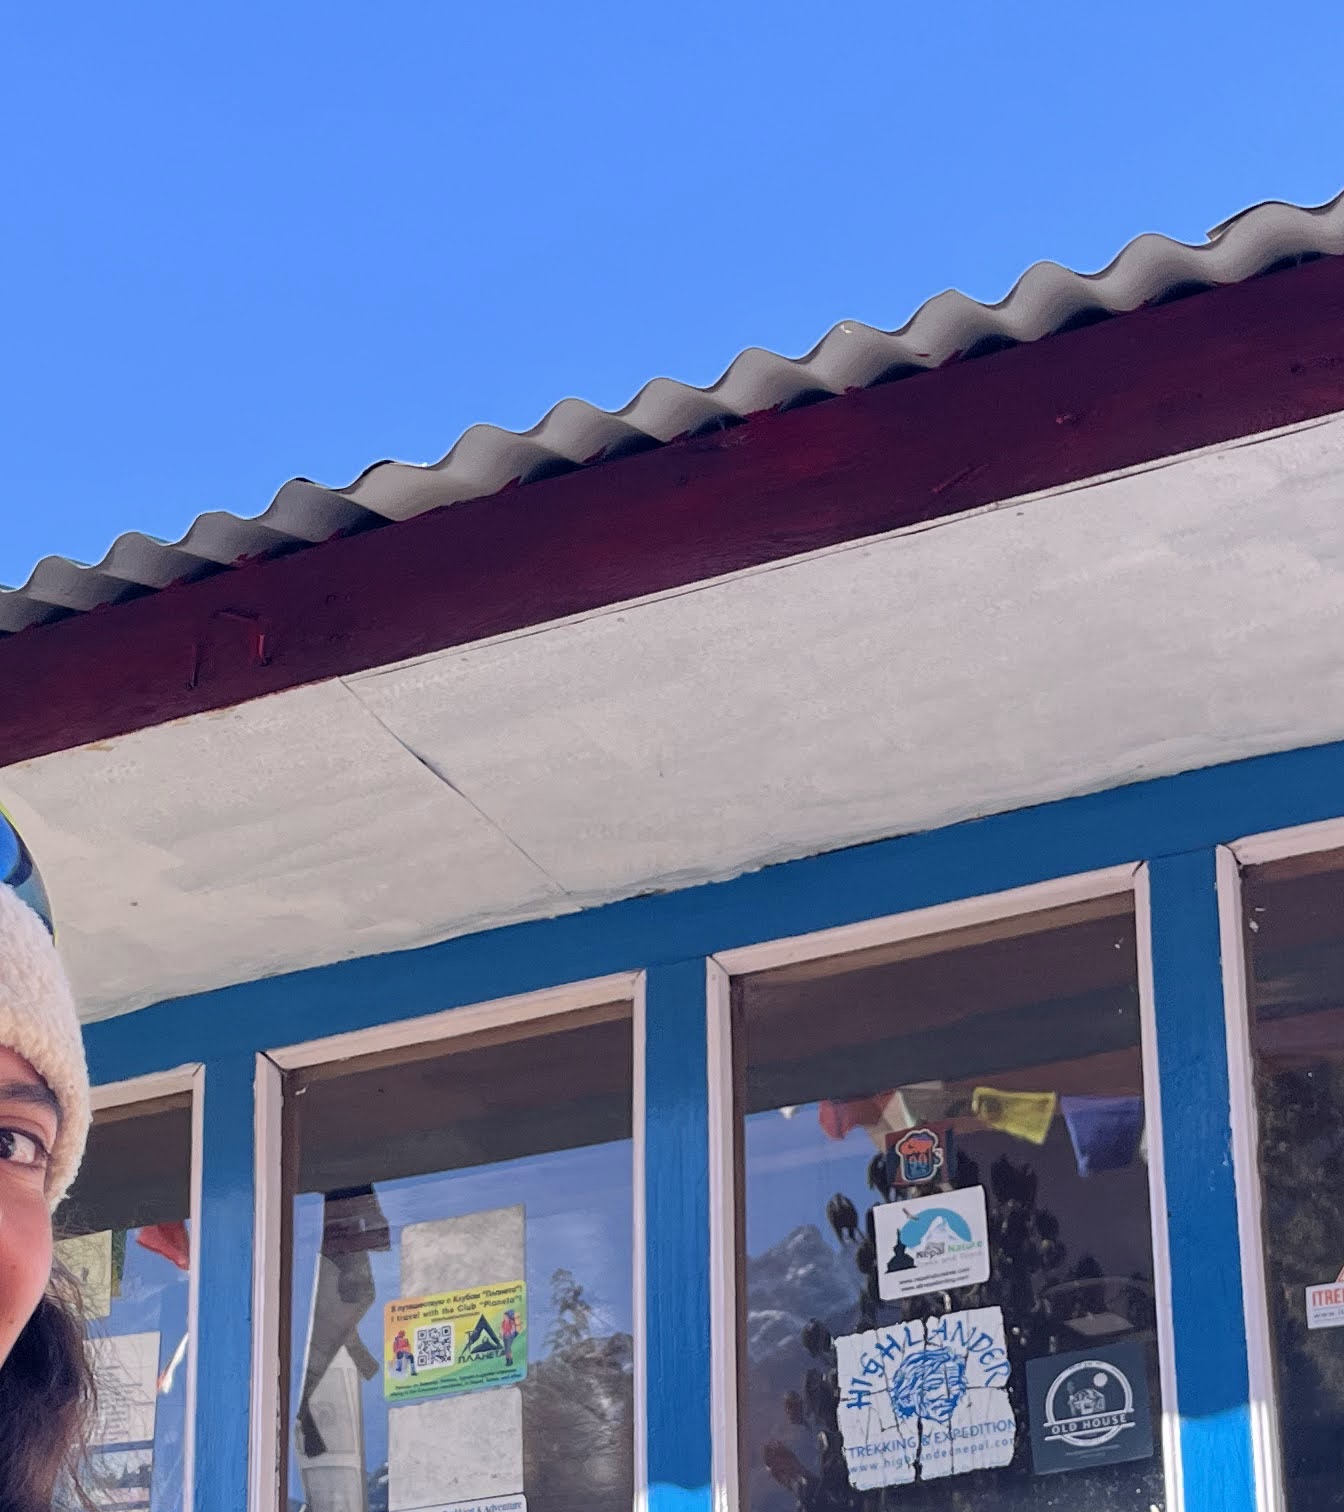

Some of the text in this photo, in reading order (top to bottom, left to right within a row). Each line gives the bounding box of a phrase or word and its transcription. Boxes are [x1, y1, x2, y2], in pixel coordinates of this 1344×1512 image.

[457, 1304, 476, 1312] Club
[846, 1319, 1012, 1409] HIGHLANDER
[1052, 1414, 1127, 1434] OLD HOUSE
[849, 1436, 917, 1458] TREKKING
[934, 1419, 1016, 1444] EXPEDITION
[484, 1501, 522, 1512] Adventure
